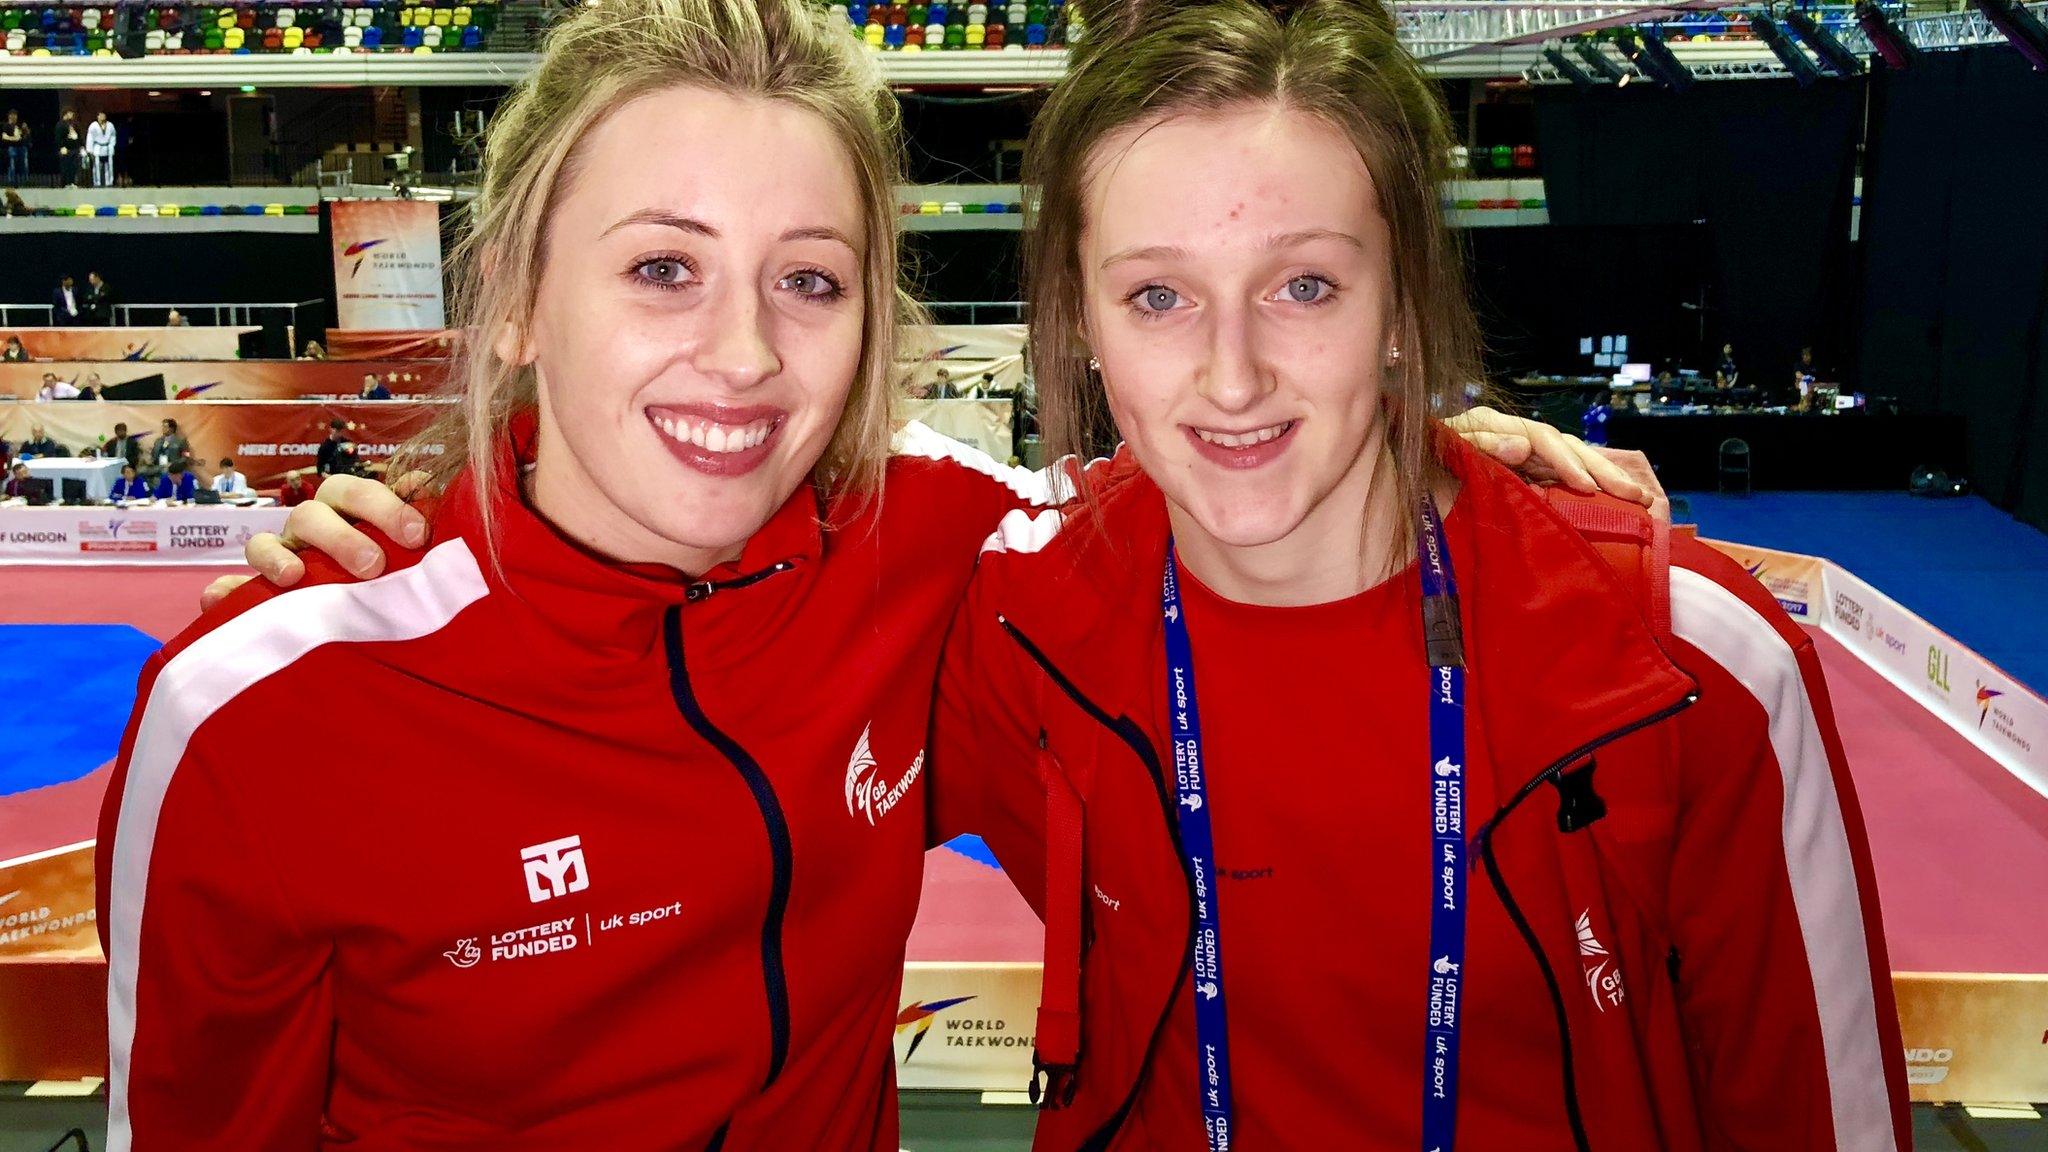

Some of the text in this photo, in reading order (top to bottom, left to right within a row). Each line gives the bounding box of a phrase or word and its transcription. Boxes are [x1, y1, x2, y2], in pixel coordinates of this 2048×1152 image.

[238, 443, 278, 456] HERE
[10, 531, 67, 543] LONDON
[170, 525, 230, 536] LOTTERY
[170, 537, 225, 548] FUNDED
[1834, 605, 1861, 632] FUNDED
[1835, 589, 1864, 616] LOTTERY
[1927, 645, 1951, 693] GLL
[1173, 667, 1189, 731] uk sport
[876, 748, 925, 818] TAEKWONDO
[1175, 740, 1189, 790] LOTTERY
[1186, 739, 1201, 790] FUNDED
[872, 779, 888, 801] GB
[1434, 780, 1448, 834] FUNDED
[1449, 780, 1461, 834] LOTTERY
[1192, 856, 1207, 919] uk sport
[1441, 843, 1457, 911] uk sport
[491, 917, 576, 946] LOTTERY
[600, 901, 683, 931] uk sport
[491, 934, 578, 962] FUNDED
[1194, 930, 1206, 978] LOTTER
[1204, 928, 1217, 979] FUNDED
[946, 1019, 1006, 1030] WORLD
[1429, 977, 1444, 1027] FUNDED
[1443, 978, 1457, 1028] LOTTERY
[1205, 1044, 1220, 1107] uk sport
[1432, 1036, 1449, 1099] uk sport
